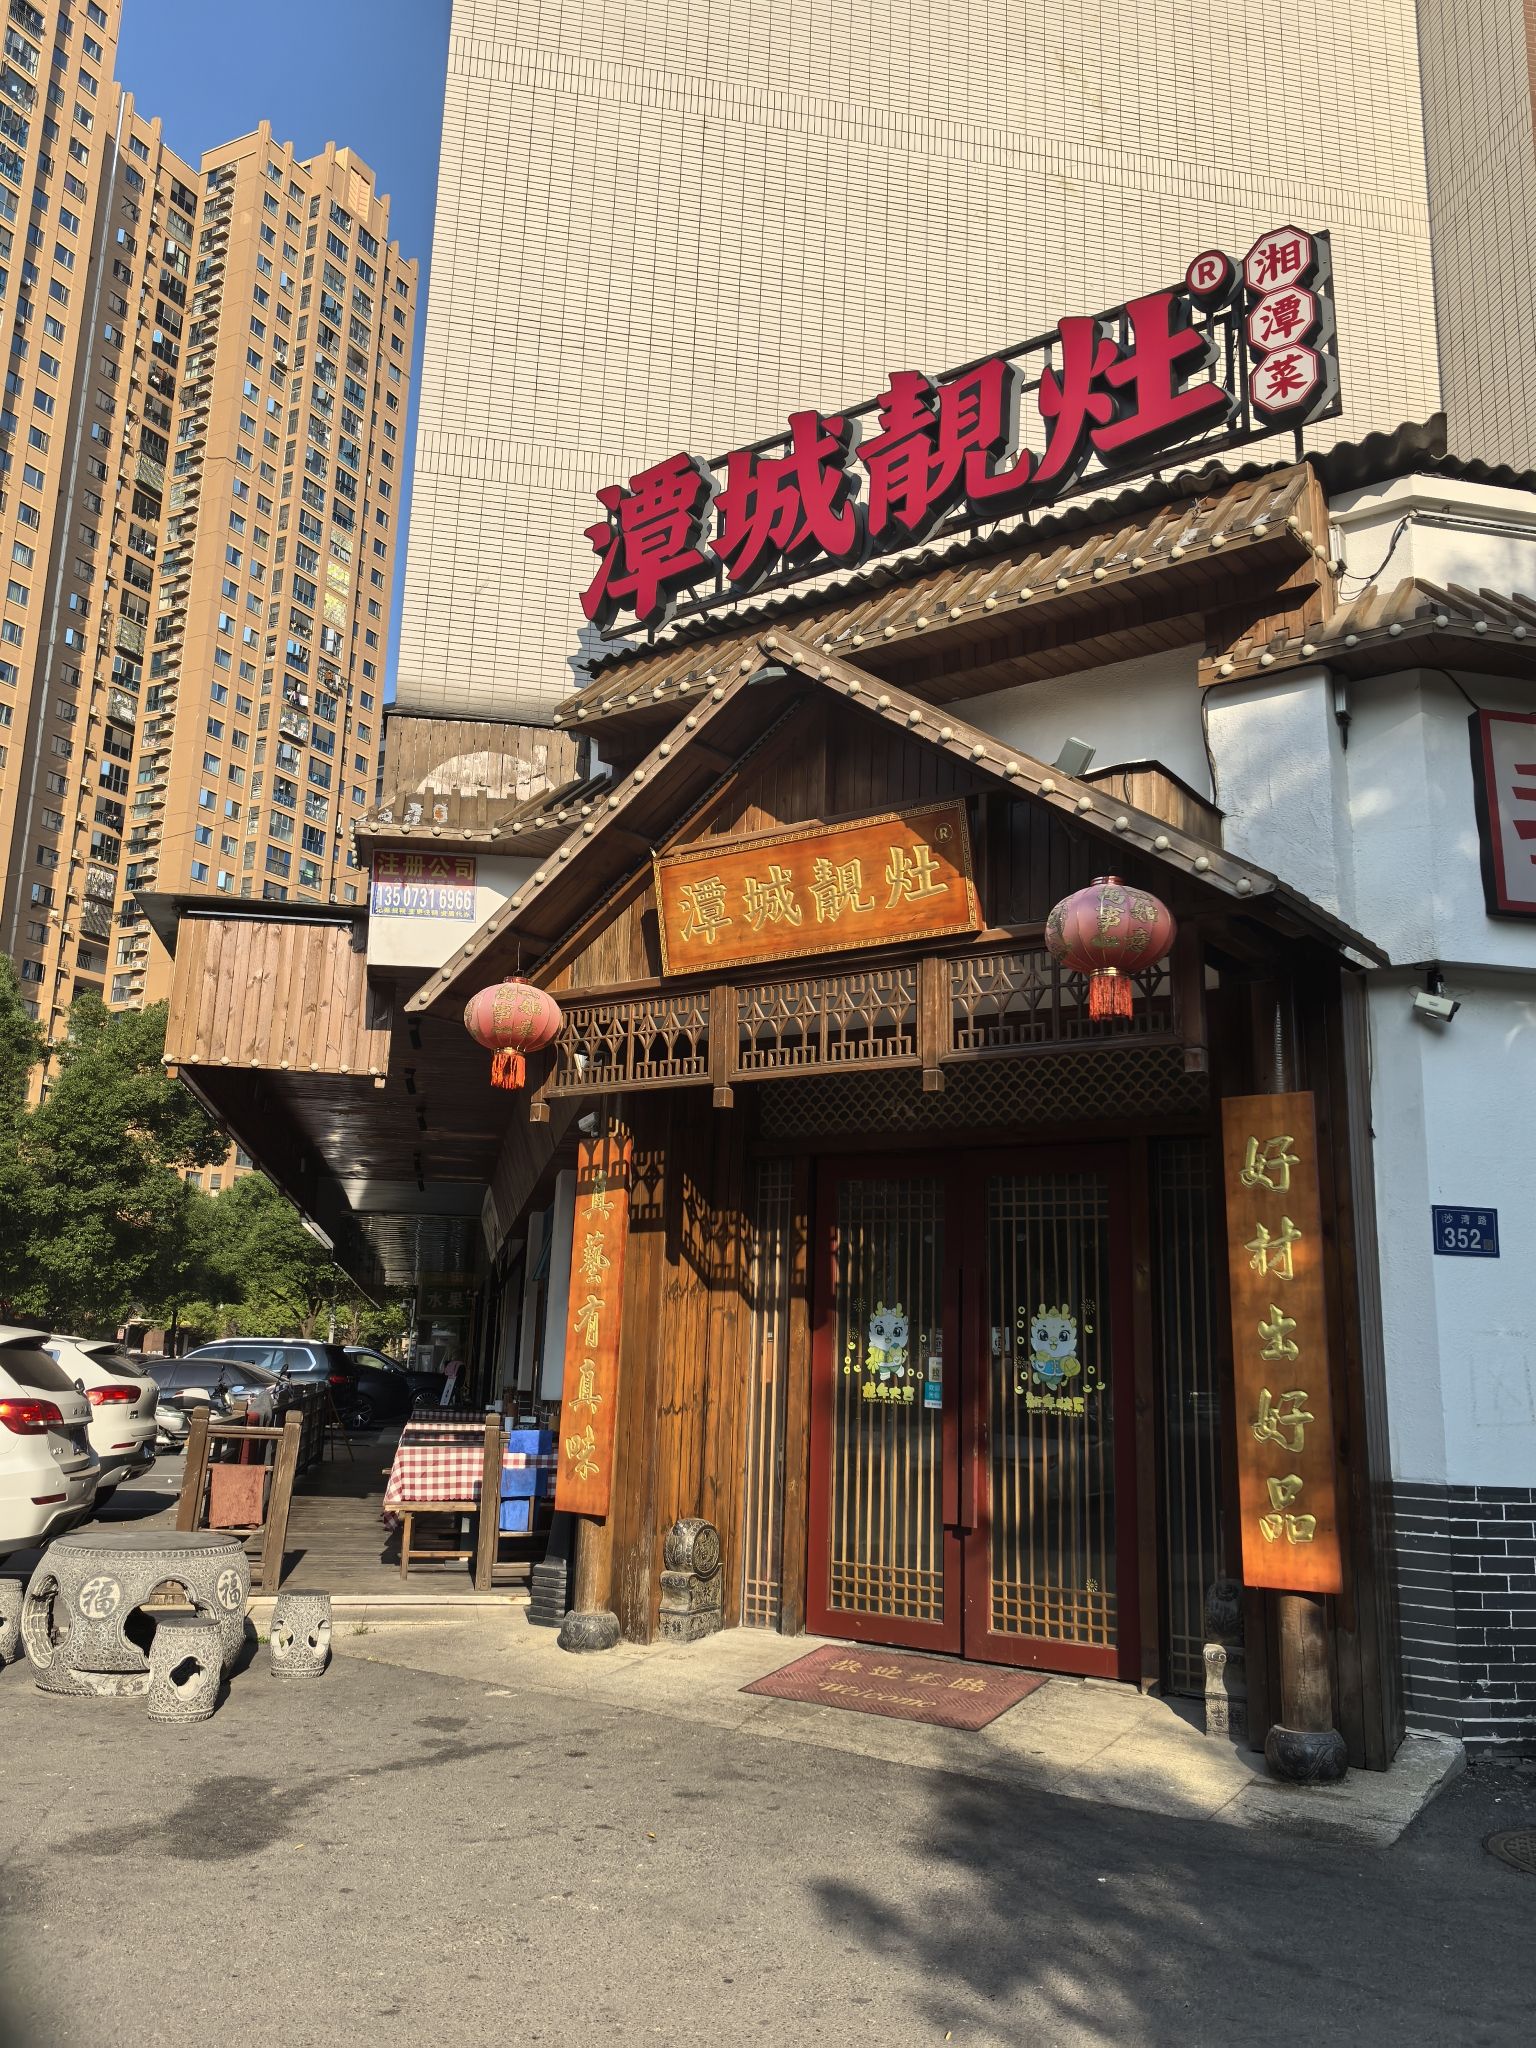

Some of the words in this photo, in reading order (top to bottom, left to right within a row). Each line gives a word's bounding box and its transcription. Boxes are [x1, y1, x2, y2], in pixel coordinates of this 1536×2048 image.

[1254, 239, 1308, 400] 湘潭菜
[579, 291, 1226, 621] 潭城靚灶
[377, 853, 474, 881] 注册公司
[377, 884, 401, 907] 135
[403, 886, 435, 909] 0731
[439, 888, 472, 911] 6966
[677, 844, 950, 945] 潭城靚灶
[1444, 1227, 1482, 1249] 352
[1238, 1133, 1317, 1545] 好材出好品
[80, 1579, 116, 1615] 福
[219, 1571, 242, 1605] 福
[818, 1680, 938, 1709] Welcome
